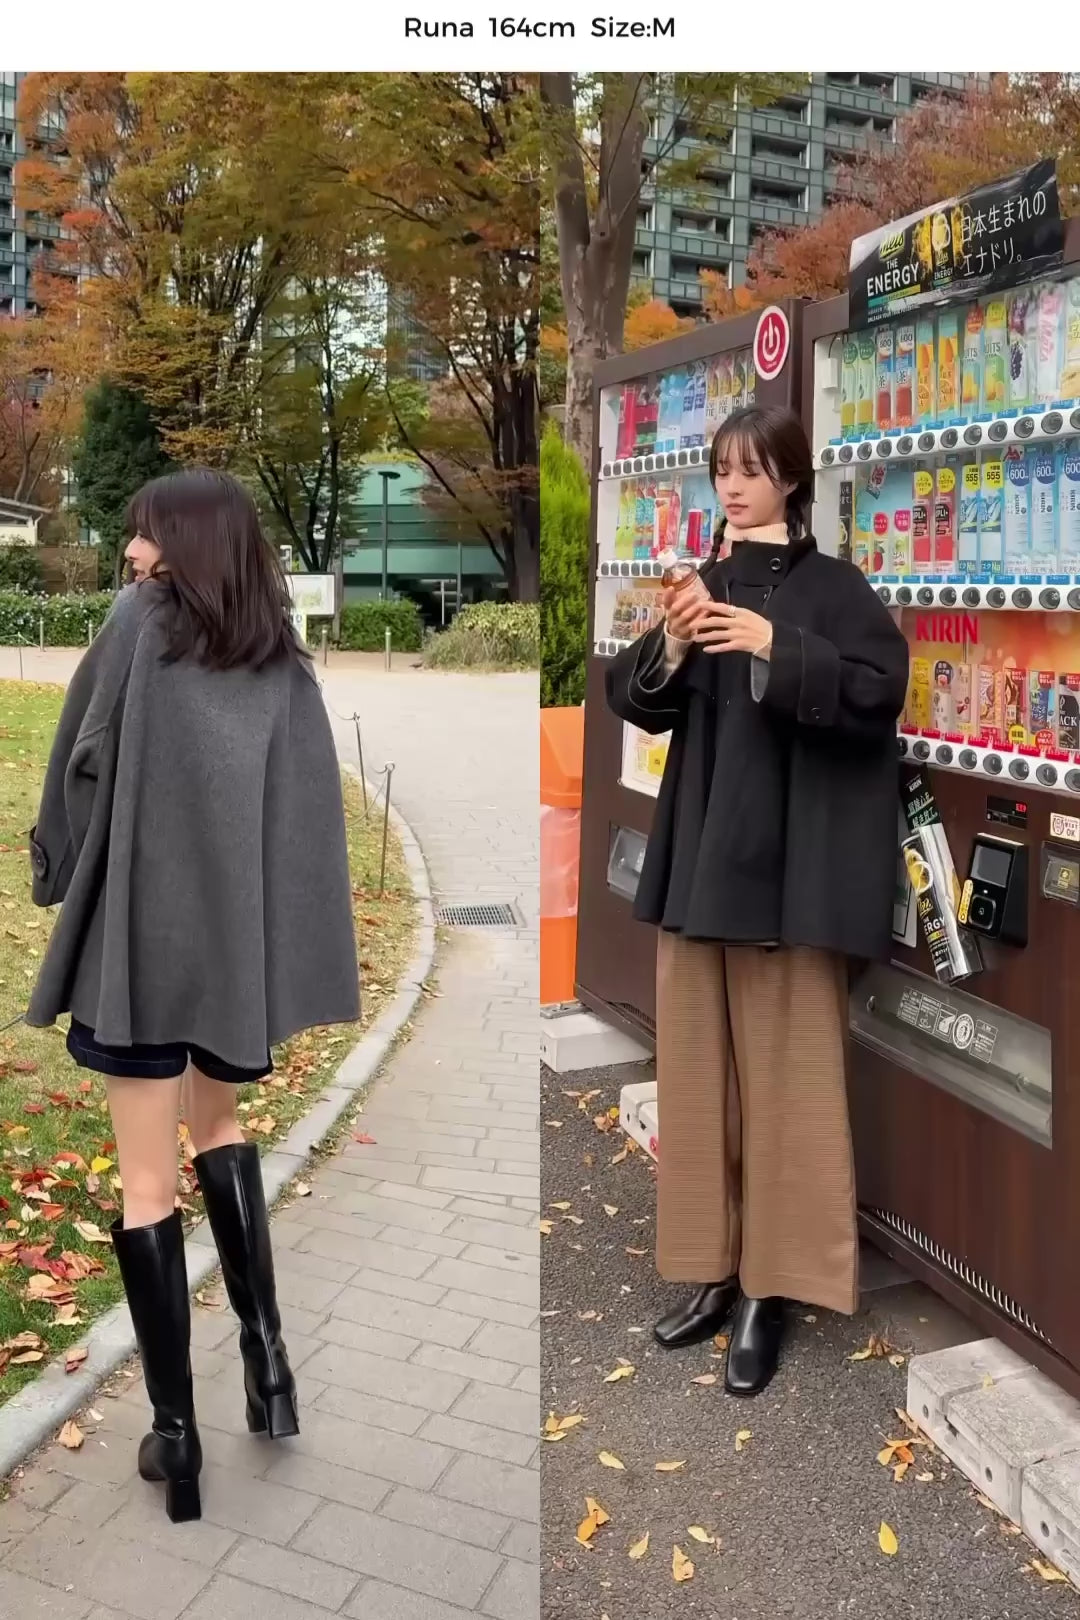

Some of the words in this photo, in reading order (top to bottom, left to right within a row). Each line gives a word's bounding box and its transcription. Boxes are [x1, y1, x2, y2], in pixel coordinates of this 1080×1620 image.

[961, 190, 1047, 243] 日本生まれの
[886, 257, 898, 271] THE
[963, 236, 1023, 277] エナドリ。
[866, 261, 919, 298] ENERGY
[934, 267, 953, 281] ENERGY
[916, 612, 979, 644] KIRIN
[909, 778, 922, 793] KIRIN
